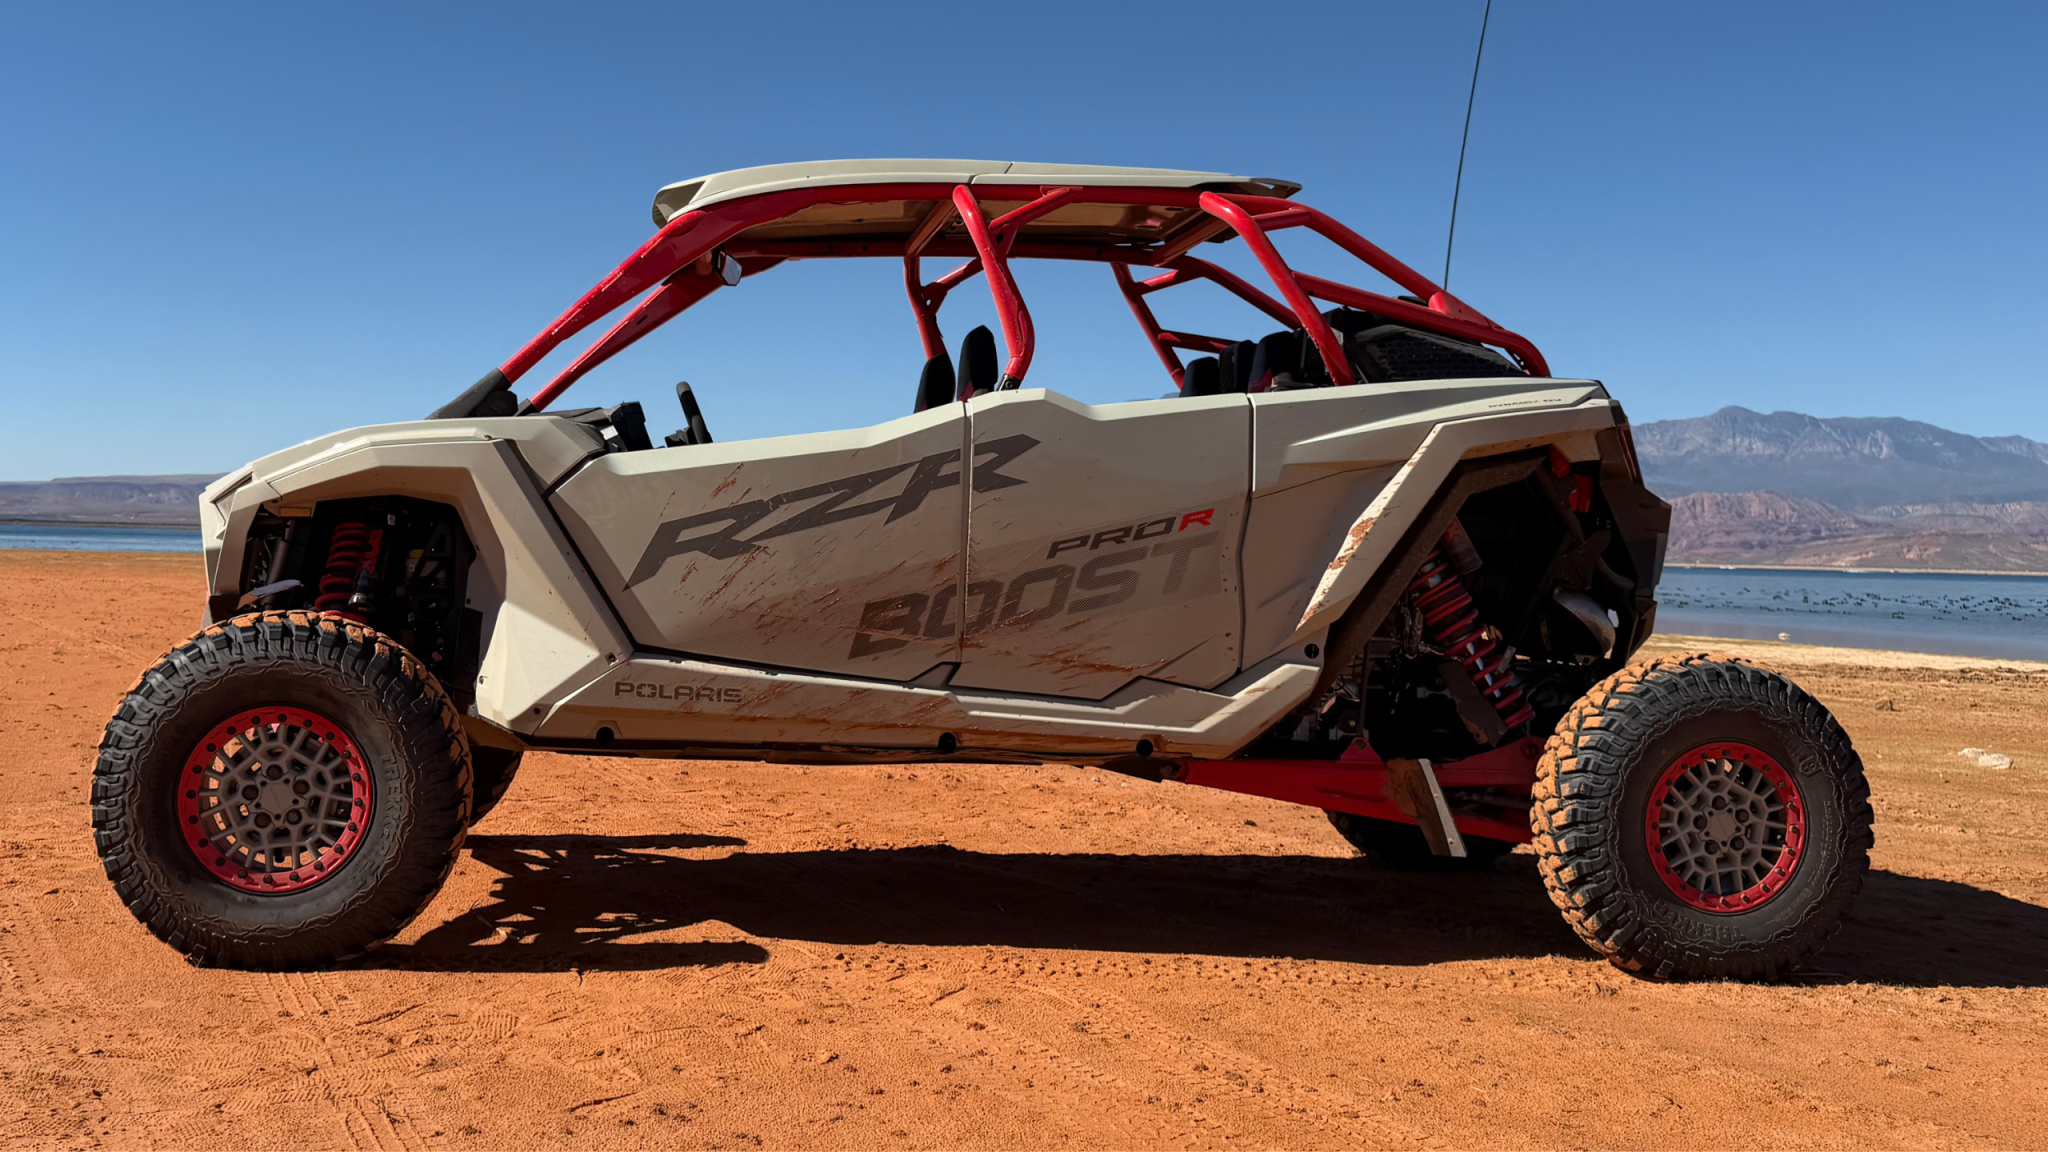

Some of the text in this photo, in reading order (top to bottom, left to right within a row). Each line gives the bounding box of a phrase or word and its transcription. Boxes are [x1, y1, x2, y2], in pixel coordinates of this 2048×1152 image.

[621, 433, 1041, 592] RZR
[847, 530, 1220, 660] BOOST
[614, 681, 743, 704] POLARIS
